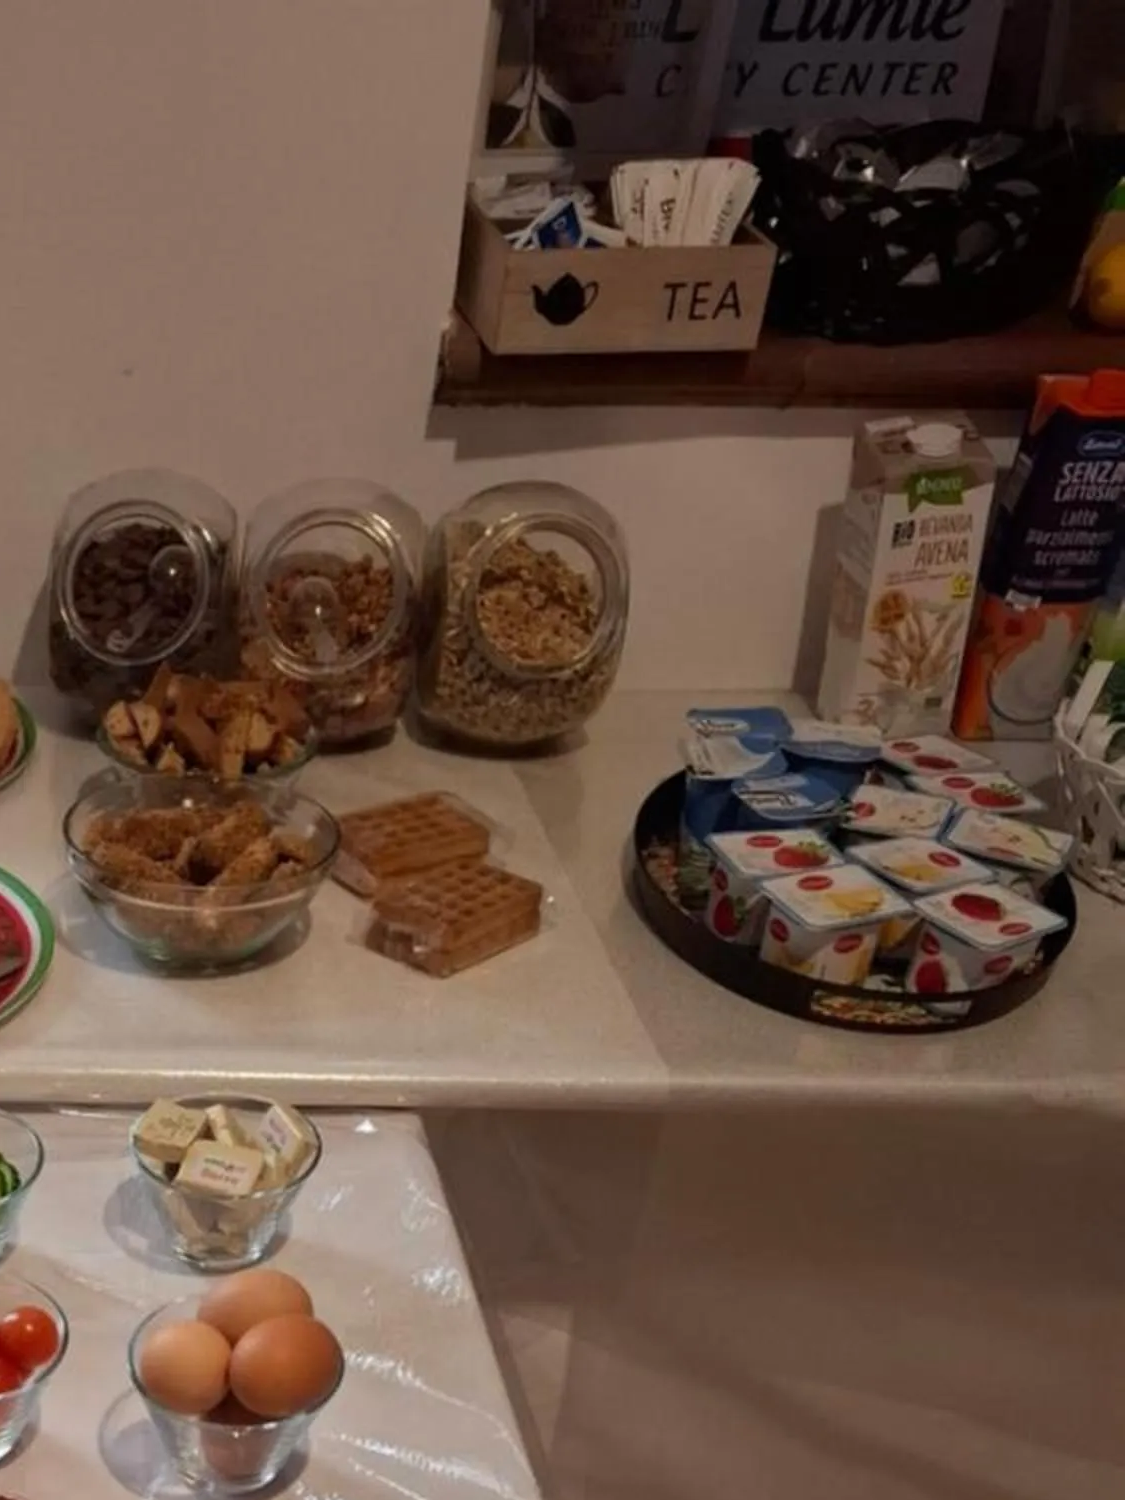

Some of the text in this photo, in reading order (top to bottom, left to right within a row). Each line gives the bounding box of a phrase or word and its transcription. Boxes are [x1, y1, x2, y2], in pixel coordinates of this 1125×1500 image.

[655, 62, 960, 98] CY CENTER
[663, 280, 743, 322] TEA
[1058, 460, 1125, 485] SENZA
[1060, 507, 1100, 528] Latte
[914, 539, 969, 567] AVENA
